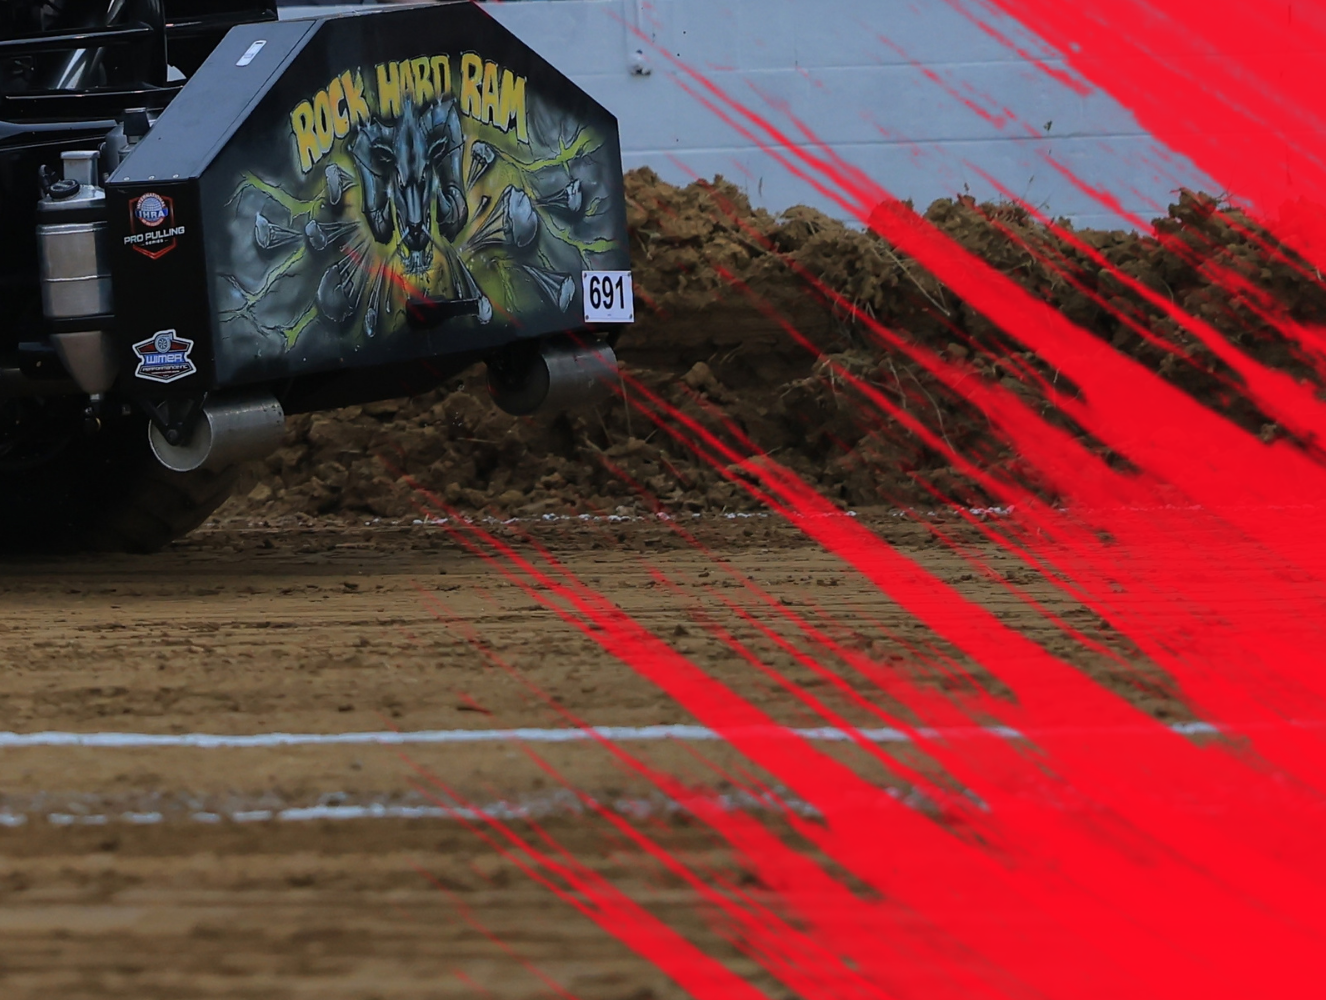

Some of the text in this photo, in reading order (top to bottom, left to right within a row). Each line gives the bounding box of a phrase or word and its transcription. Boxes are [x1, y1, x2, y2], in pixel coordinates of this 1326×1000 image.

[291, 50, 530, 174] ROCK HARD RAM
[139, 210, 165, 219] IHRA
[124, 225, 186, 246] PRO PULLING
[589, 275, 625, 311] 691
